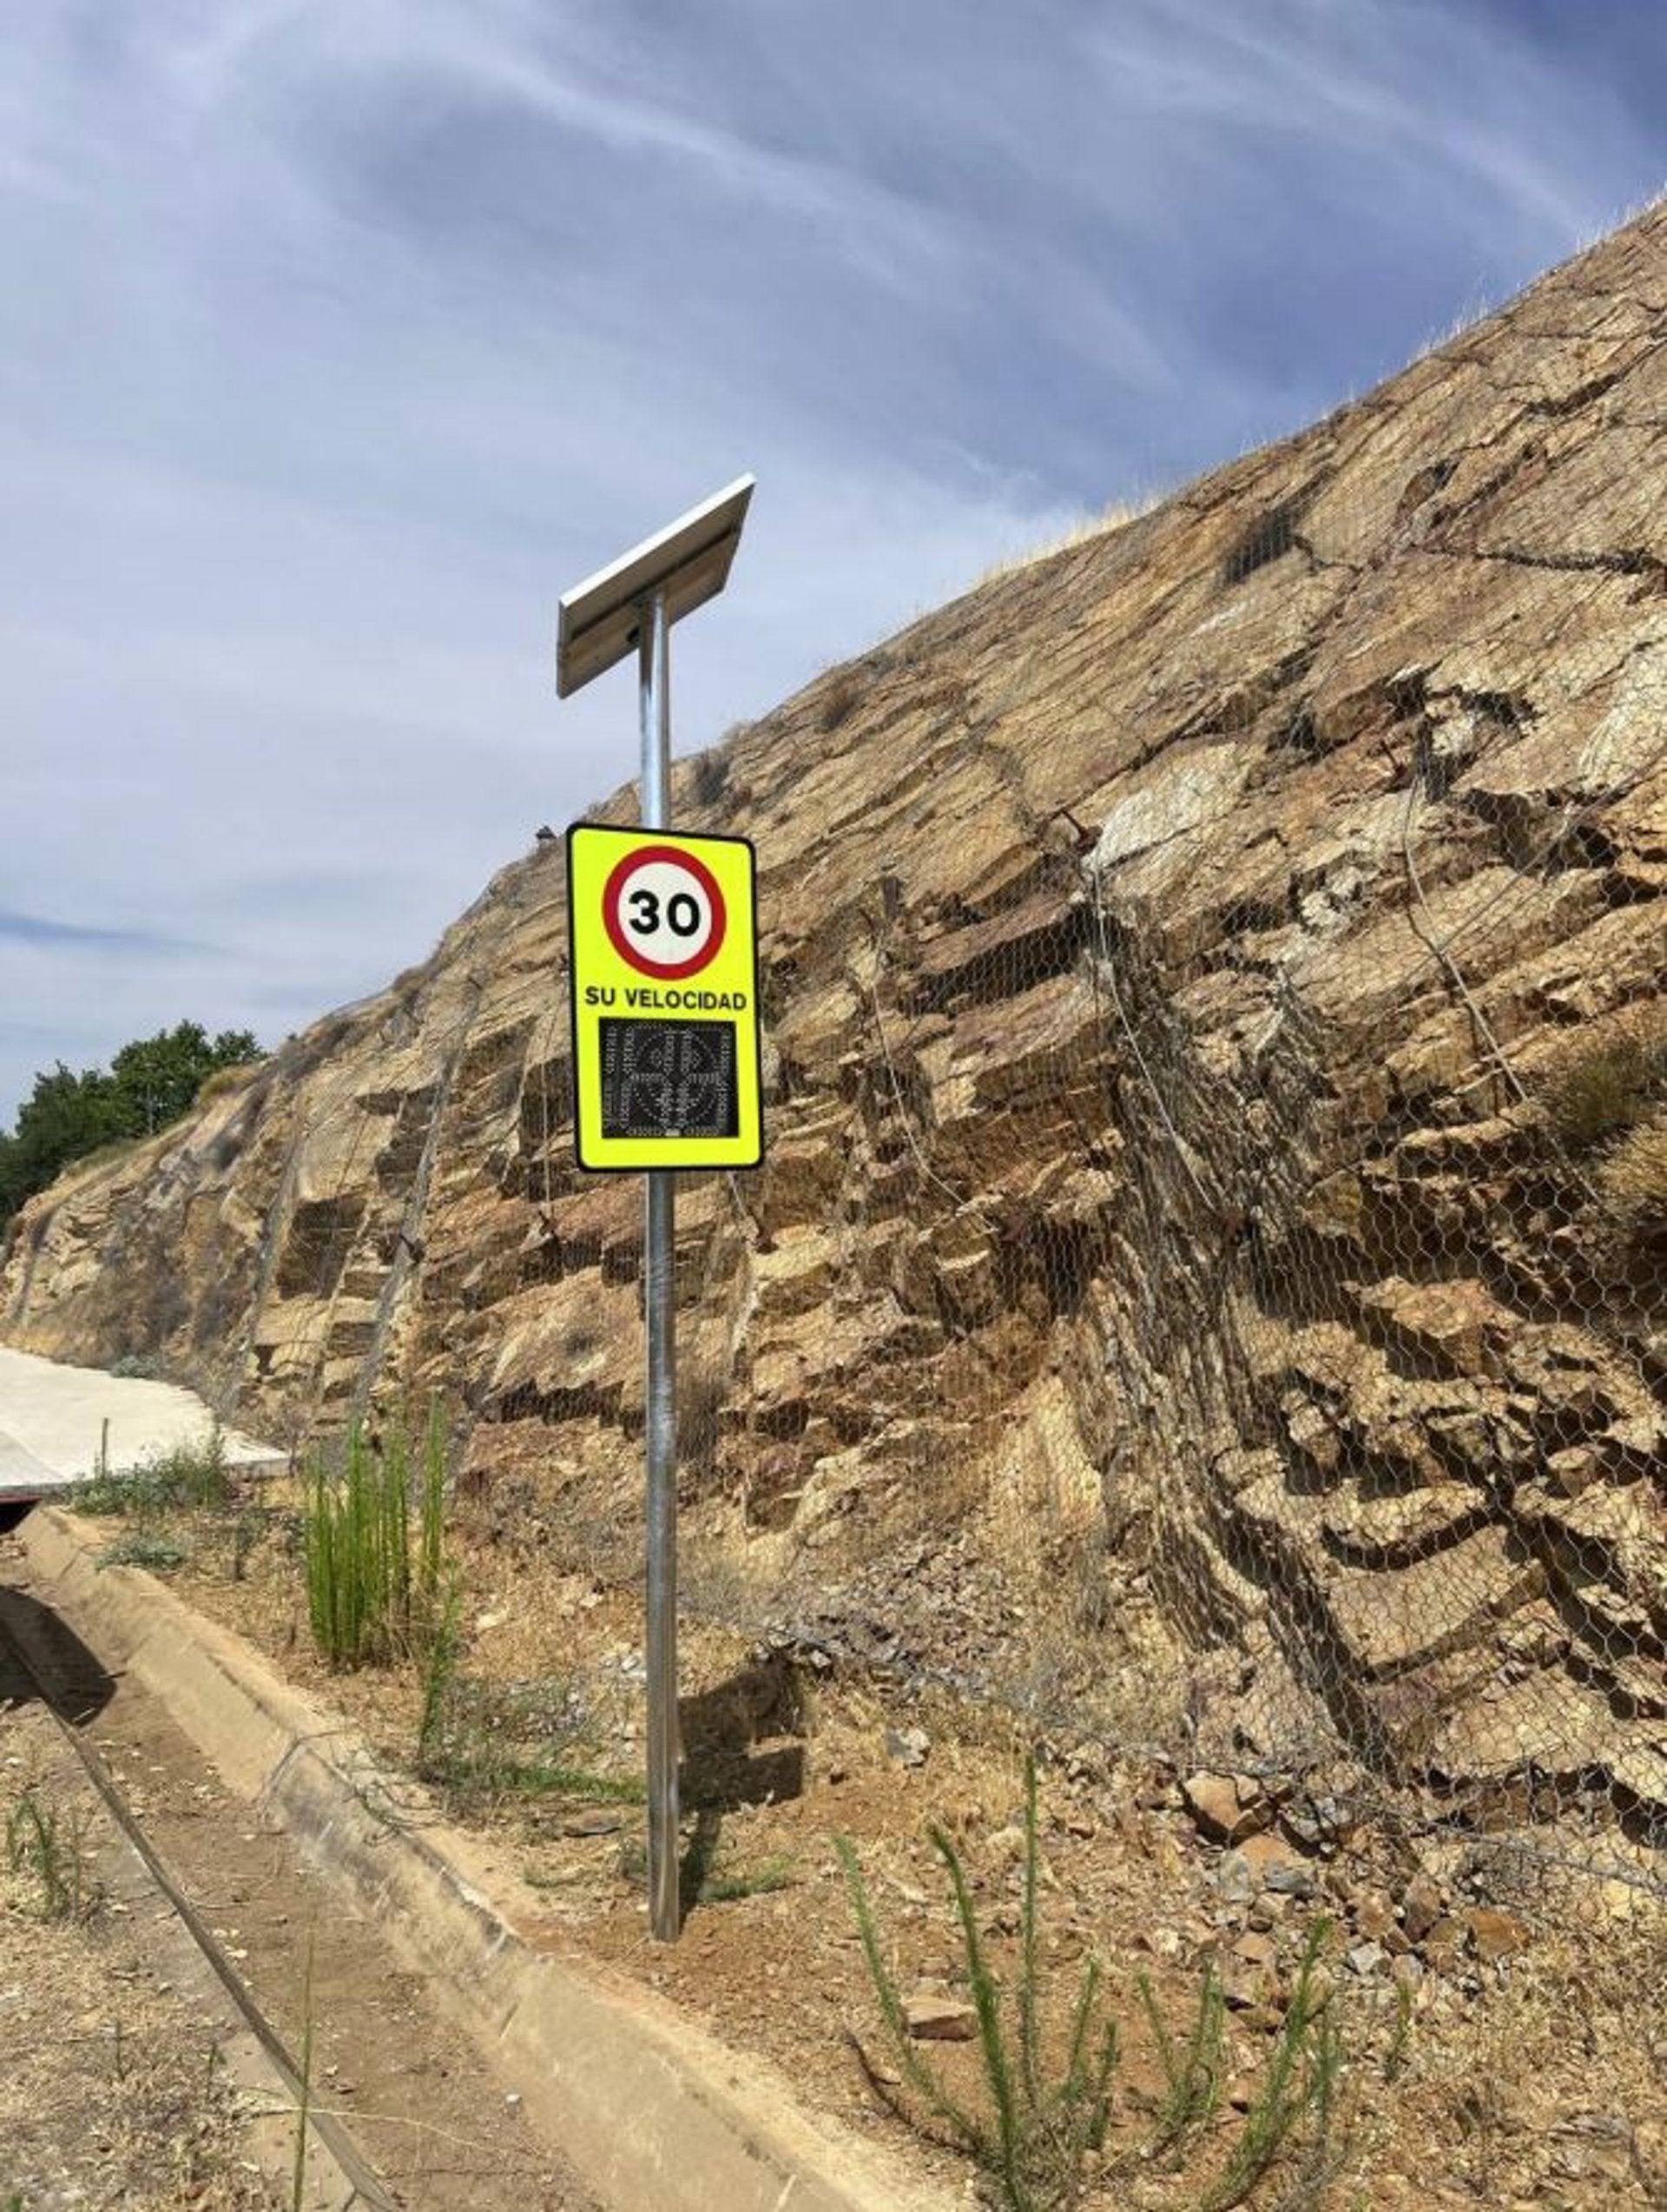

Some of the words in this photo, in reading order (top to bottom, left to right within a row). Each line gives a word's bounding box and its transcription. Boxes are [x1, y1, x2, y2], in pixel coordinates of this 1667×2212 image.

[629, 890, 701, 937] 30
[585, 986, 616, 1006] SU
[625, 988, 747, 1010] VELOCIDAD
